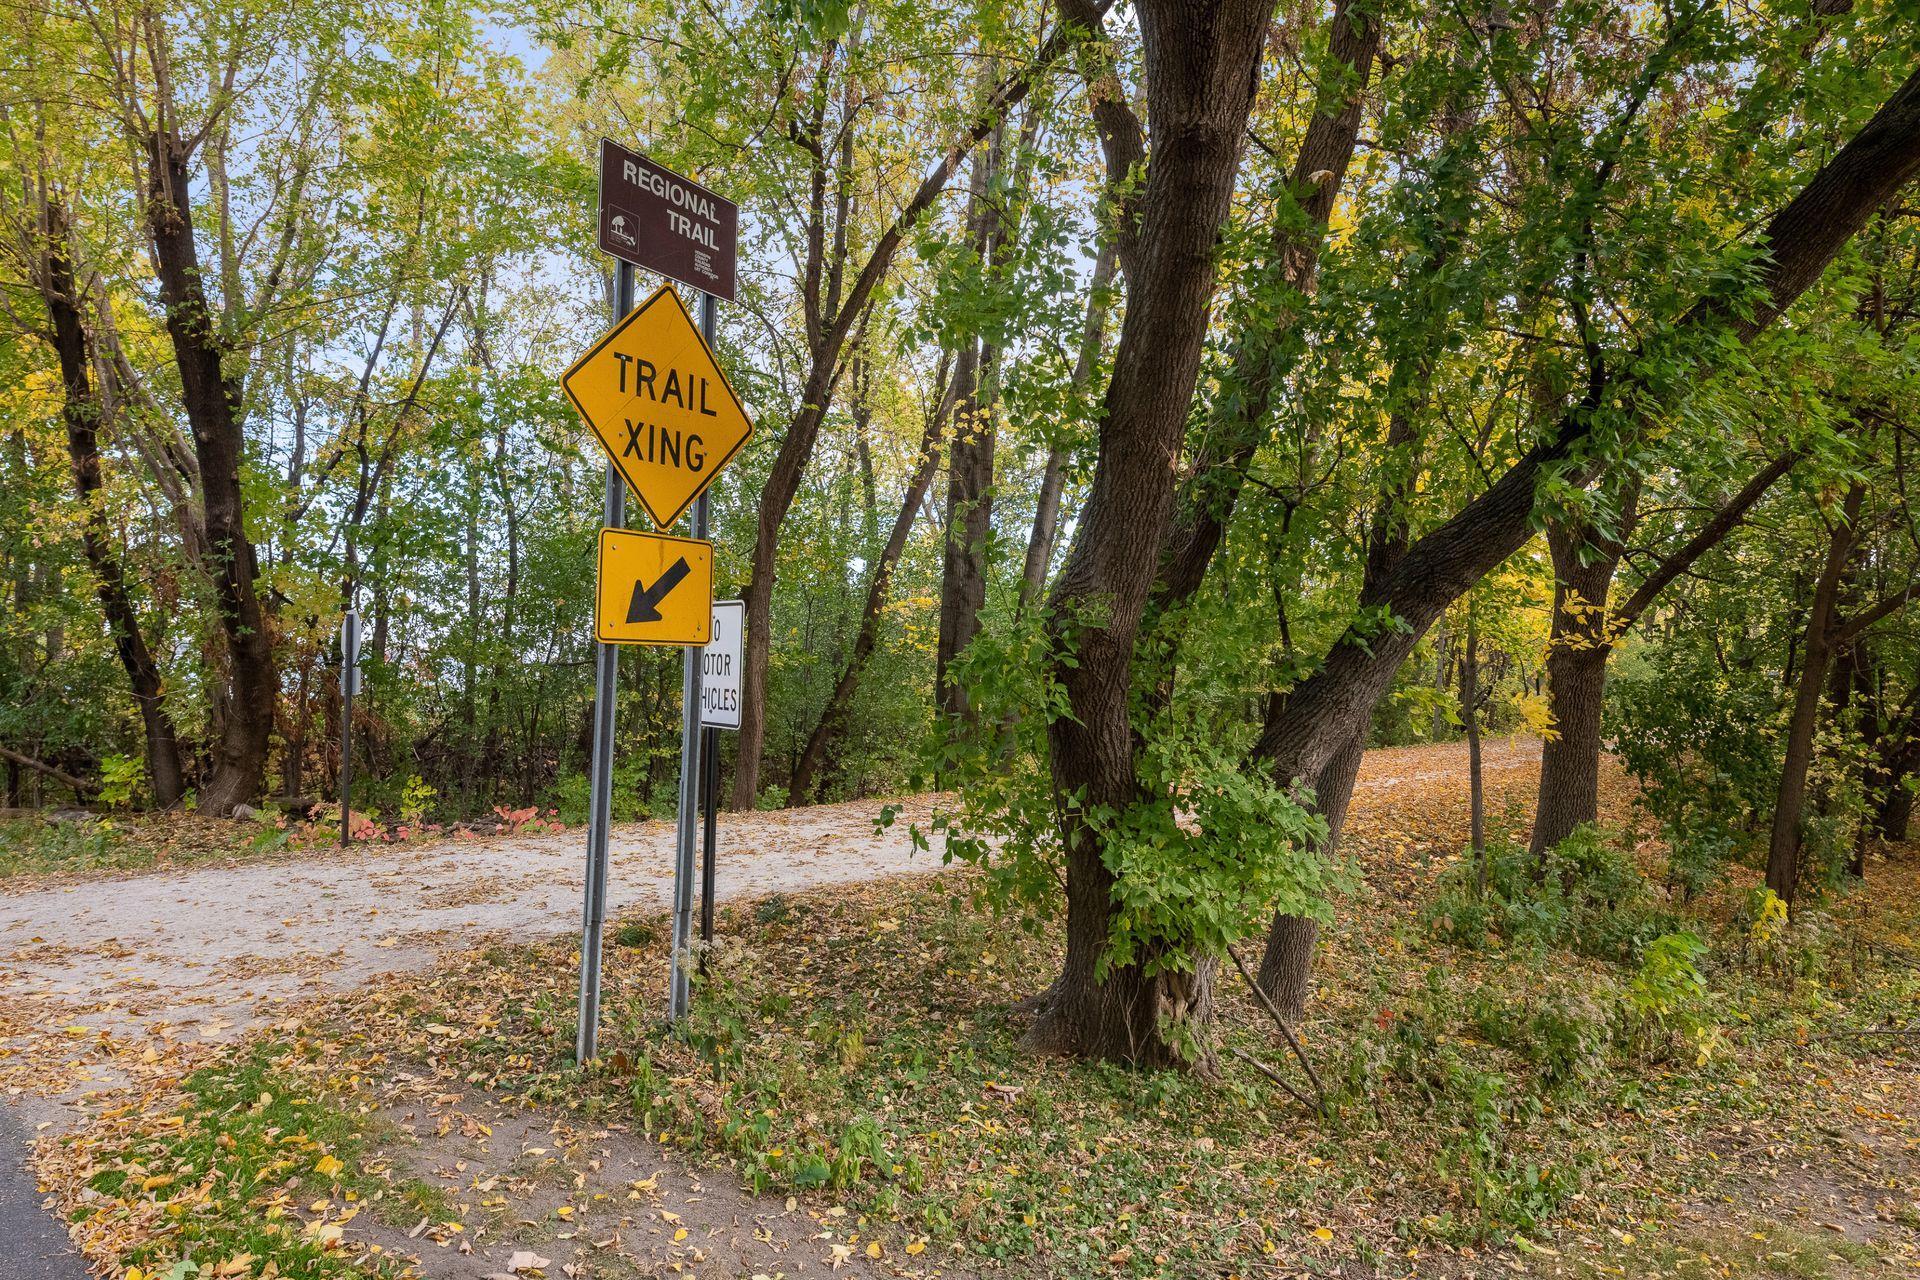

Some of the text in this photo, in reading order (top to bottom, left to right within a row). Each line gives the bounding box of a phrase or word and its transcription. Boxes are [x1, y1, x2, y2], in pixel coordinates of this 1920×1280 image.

[623, 159, 720, 225] REGIONAL
[666, 208, 720, 251] TRAIL
[613, 352, 717, 417] TRAIL
[622, 418, 704, 472] XING
[713, 619, 721, 642] O
[703, 653, 731, 676] OTOR
[702, 687, 737, 712] HICLES
